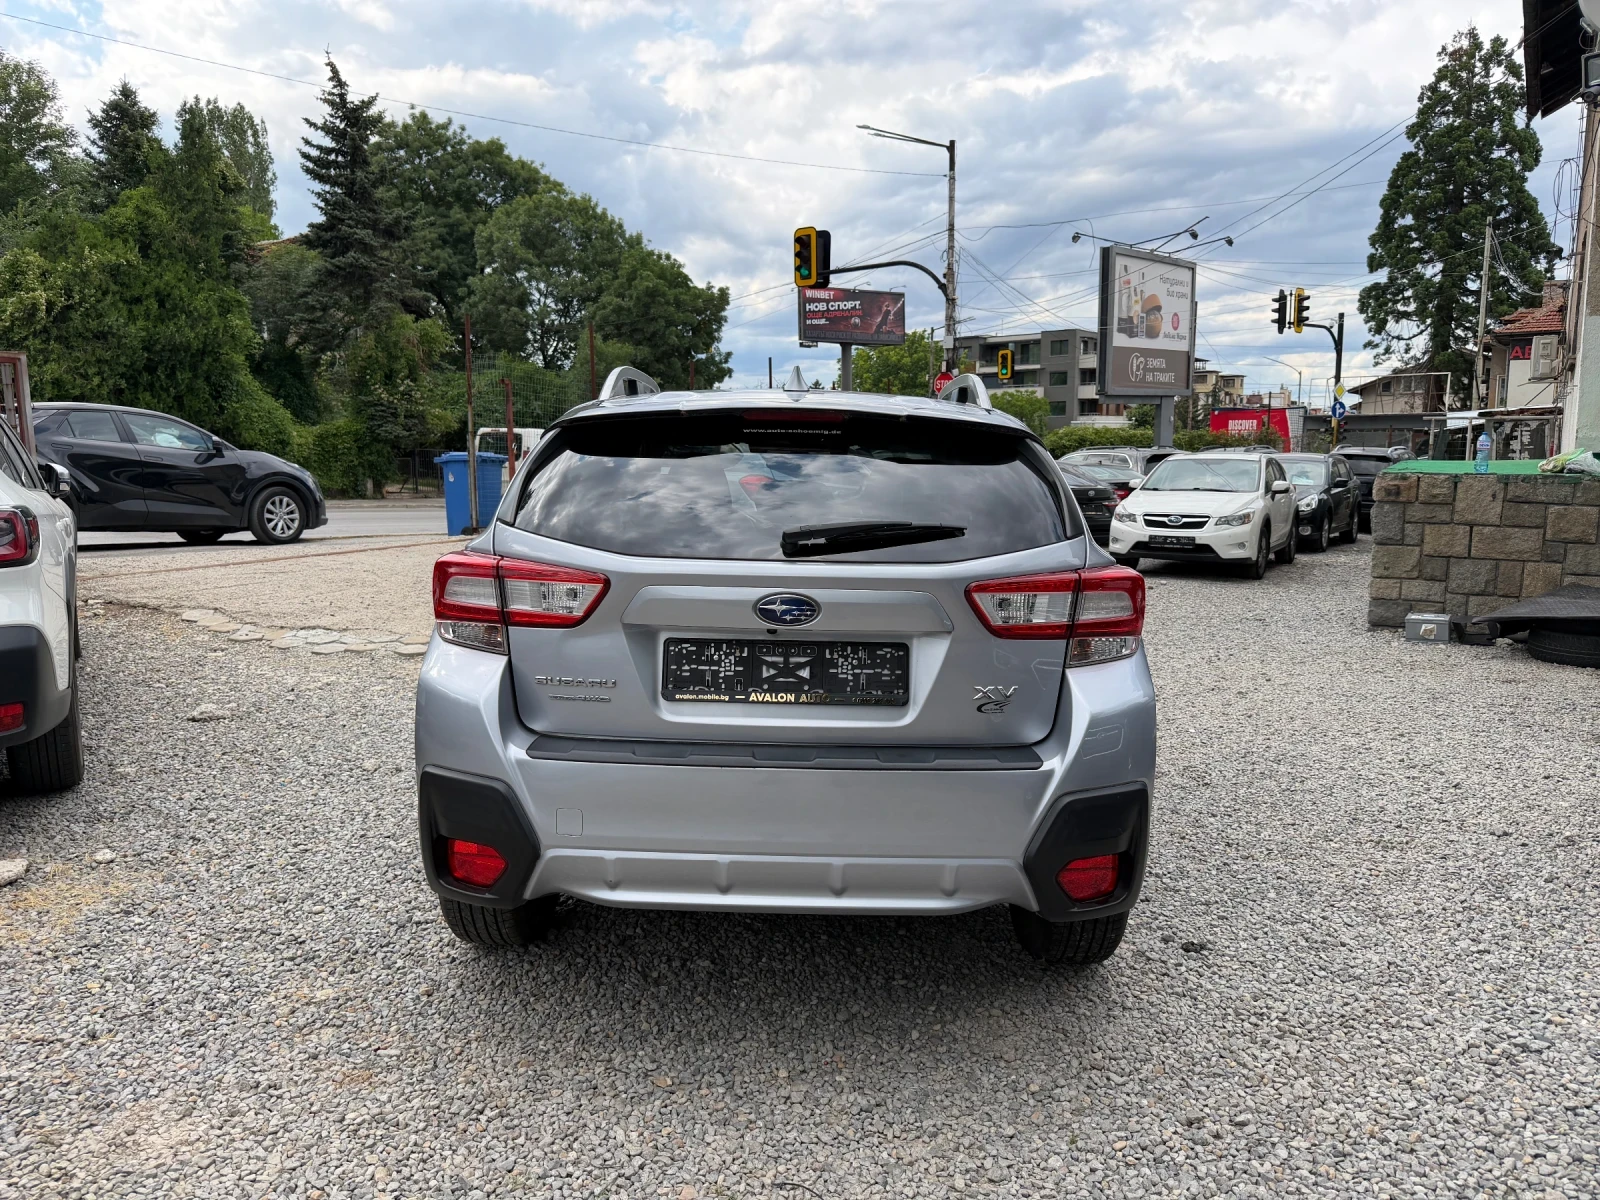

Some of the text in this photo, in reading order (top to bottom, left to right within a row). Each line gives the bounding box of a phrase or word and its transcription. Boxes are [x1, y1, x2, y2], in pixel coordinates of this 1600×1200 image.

[805, 290, 834, 300] WINBET
[806, 302, 827, 312] НОВ
[806, 311, 823, 319] ОЩЕ
[1146, 357, 1166, 369] ЗЕМЯТА
[1145, 371, 1175, 383] НА ТРАКИТЕ
[1228, 420, 1257, 430] DISCOVER
[535, 676, 617, 688] SUBARU
[973, 685, 1019, 700] XV
[675, 693, 830, 703] avalon.mobile.bg AVALON AUTO
